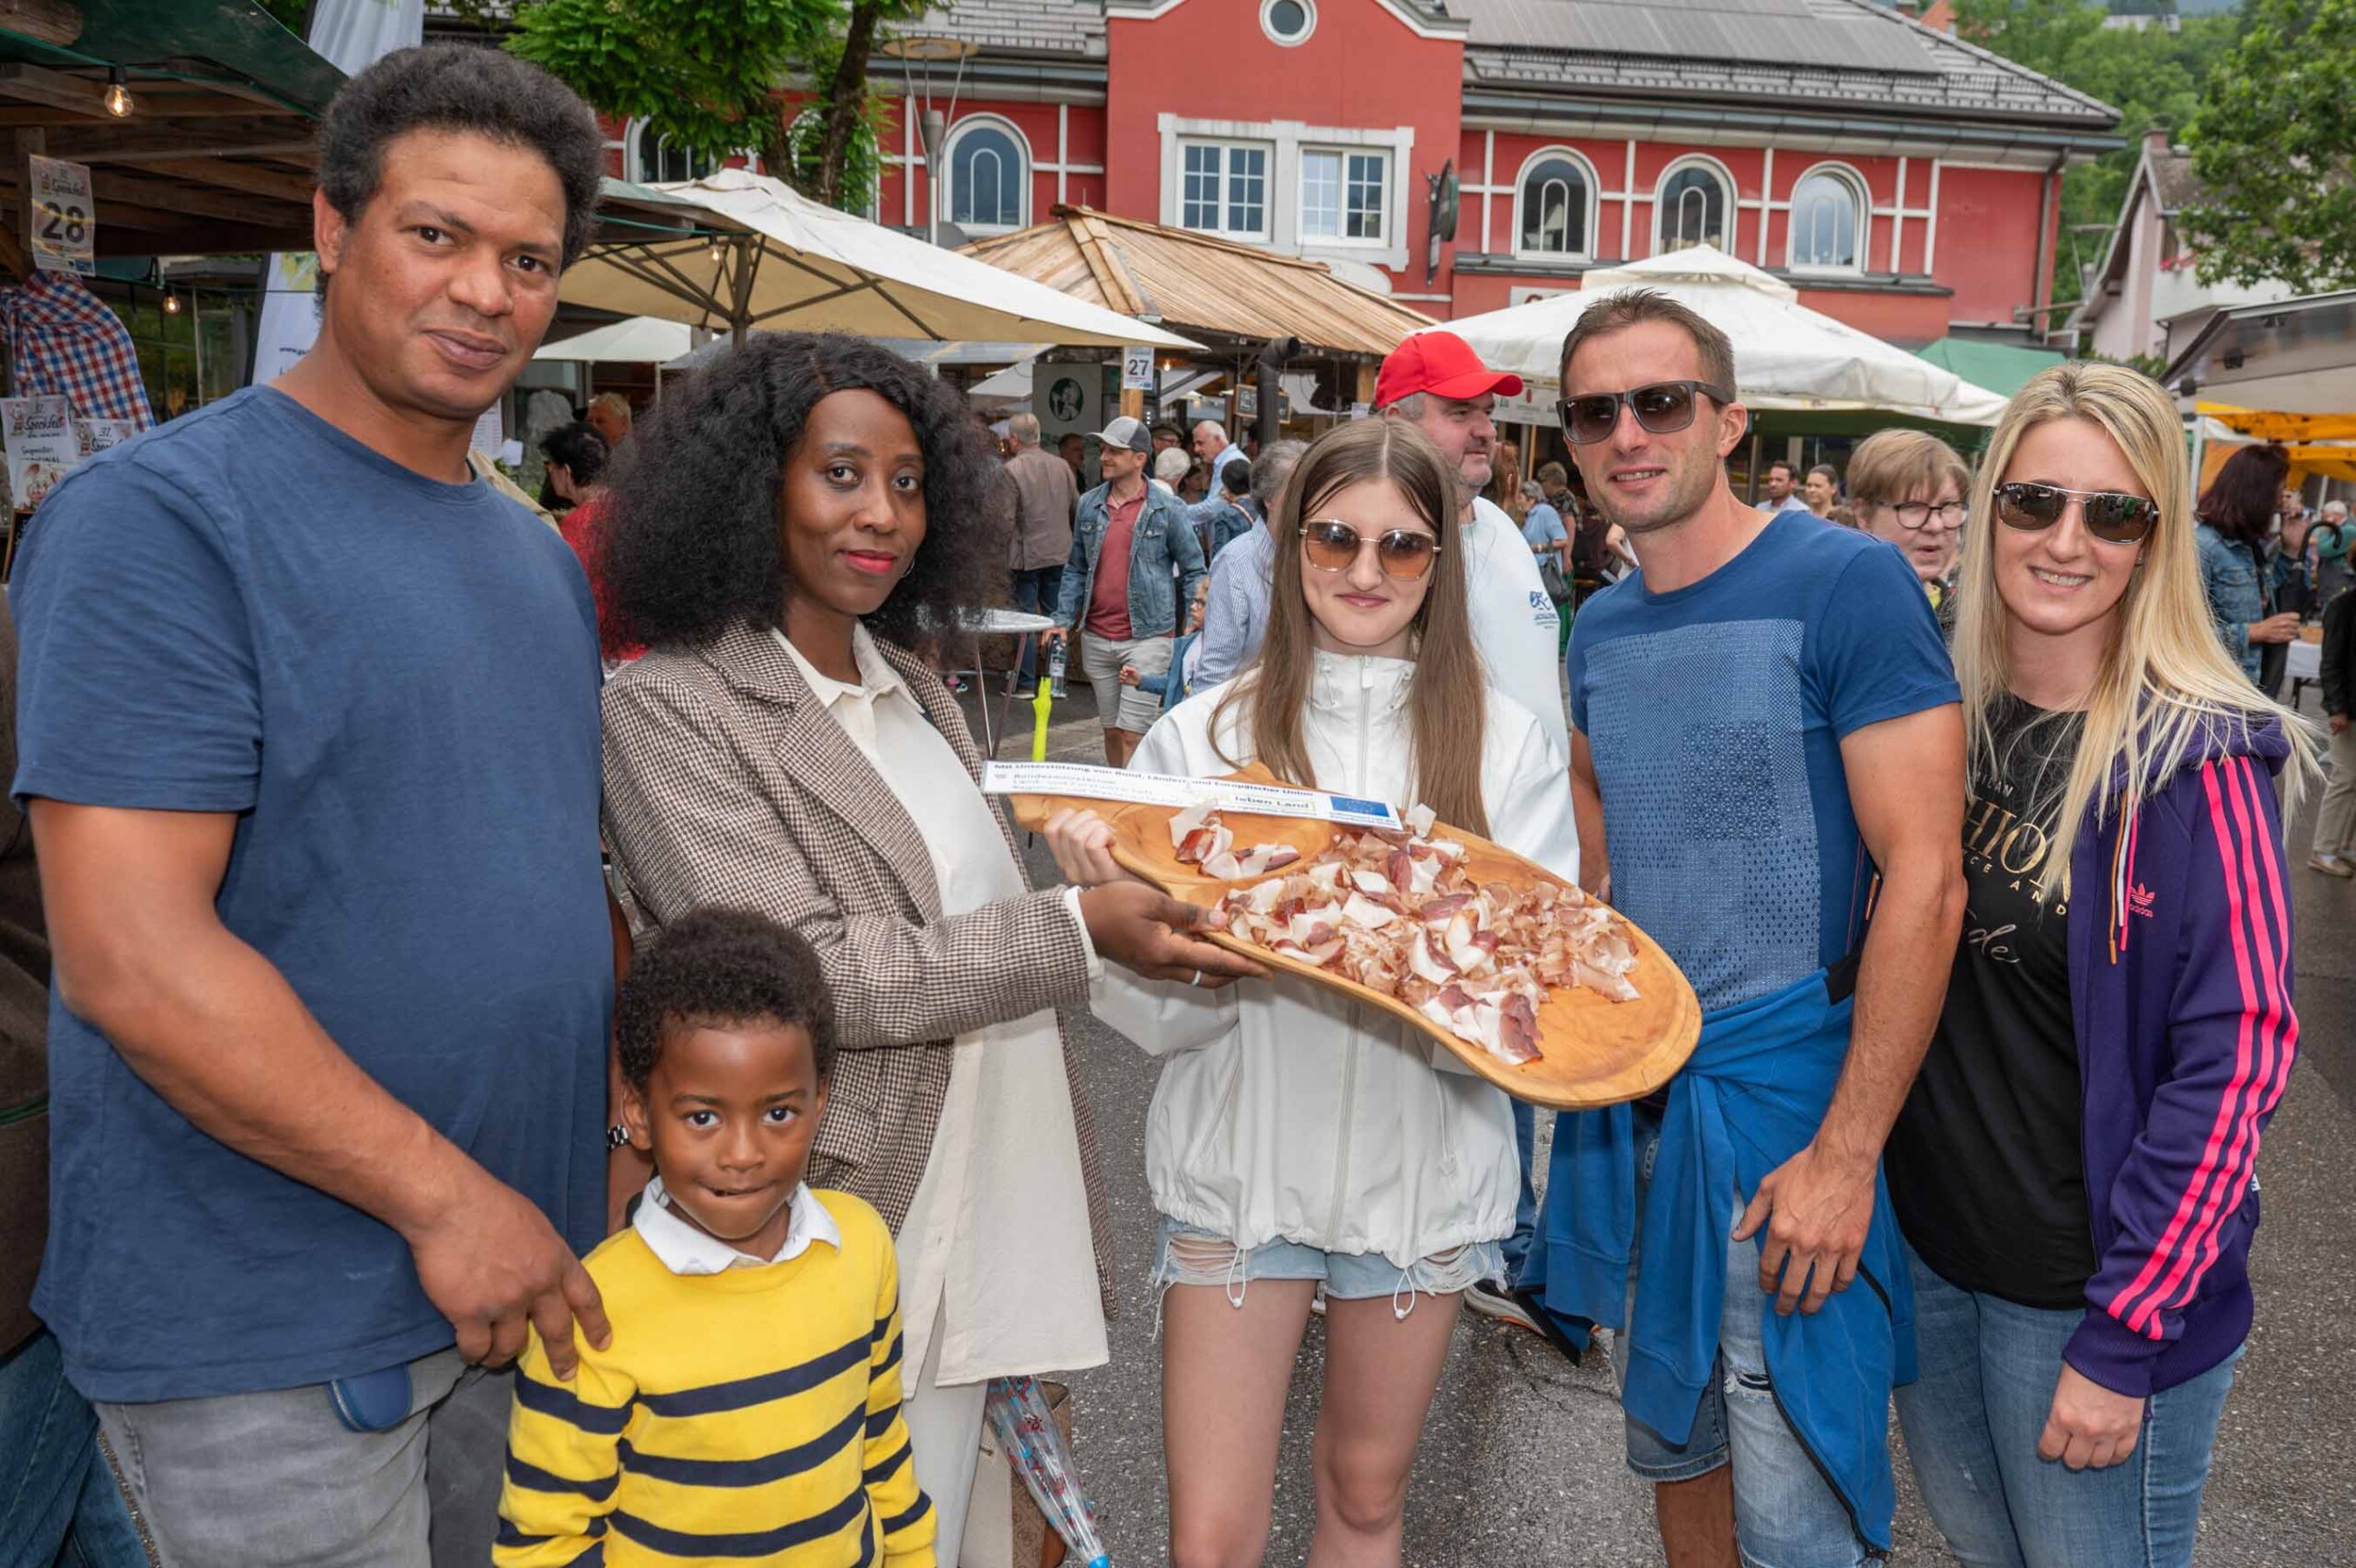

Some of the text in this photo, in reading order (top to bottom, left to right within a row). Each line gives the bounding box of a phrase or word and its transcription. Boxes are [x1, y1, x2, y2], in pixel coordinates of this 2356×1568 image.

[41, 201, 85, 244] 28
[1128, 358, 1149, 376] 27
[2009, 879, 2067, 916] AND
